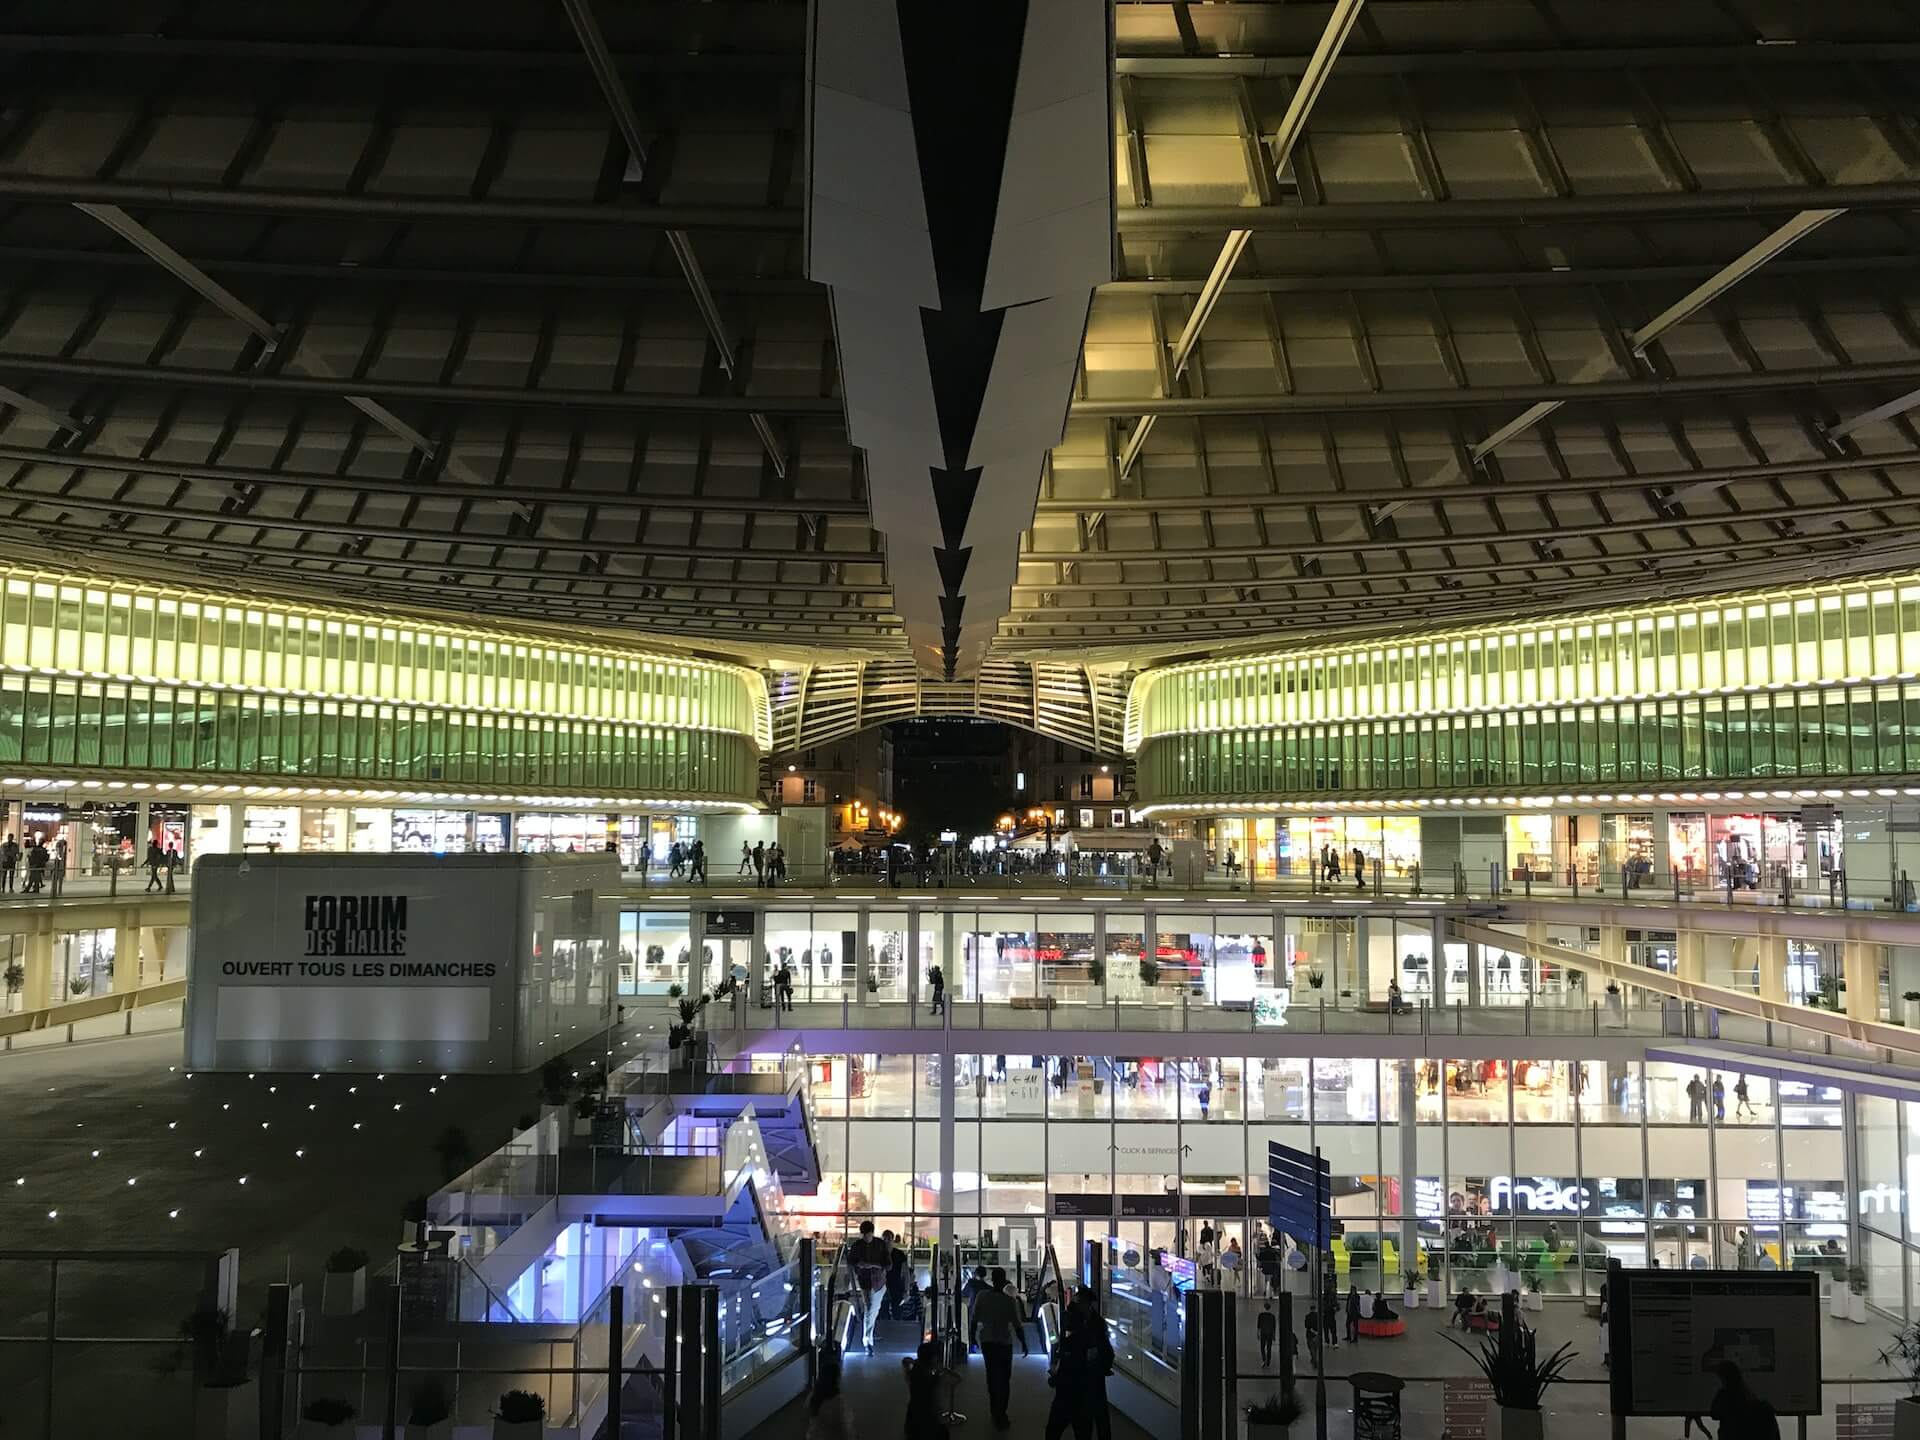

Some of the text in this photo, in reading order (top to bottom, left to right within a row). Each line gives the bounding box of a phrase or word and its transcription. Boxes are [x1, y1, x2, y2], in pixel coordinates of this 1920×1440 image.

[304, 895, 407, 930] FORUM
[304, 929, 407, 955] DES HALLES
[222, 962, 497, 978] OUVERT TOUS LES DIMANCHES
[1490, 1175, 1590, 1211] fnac
